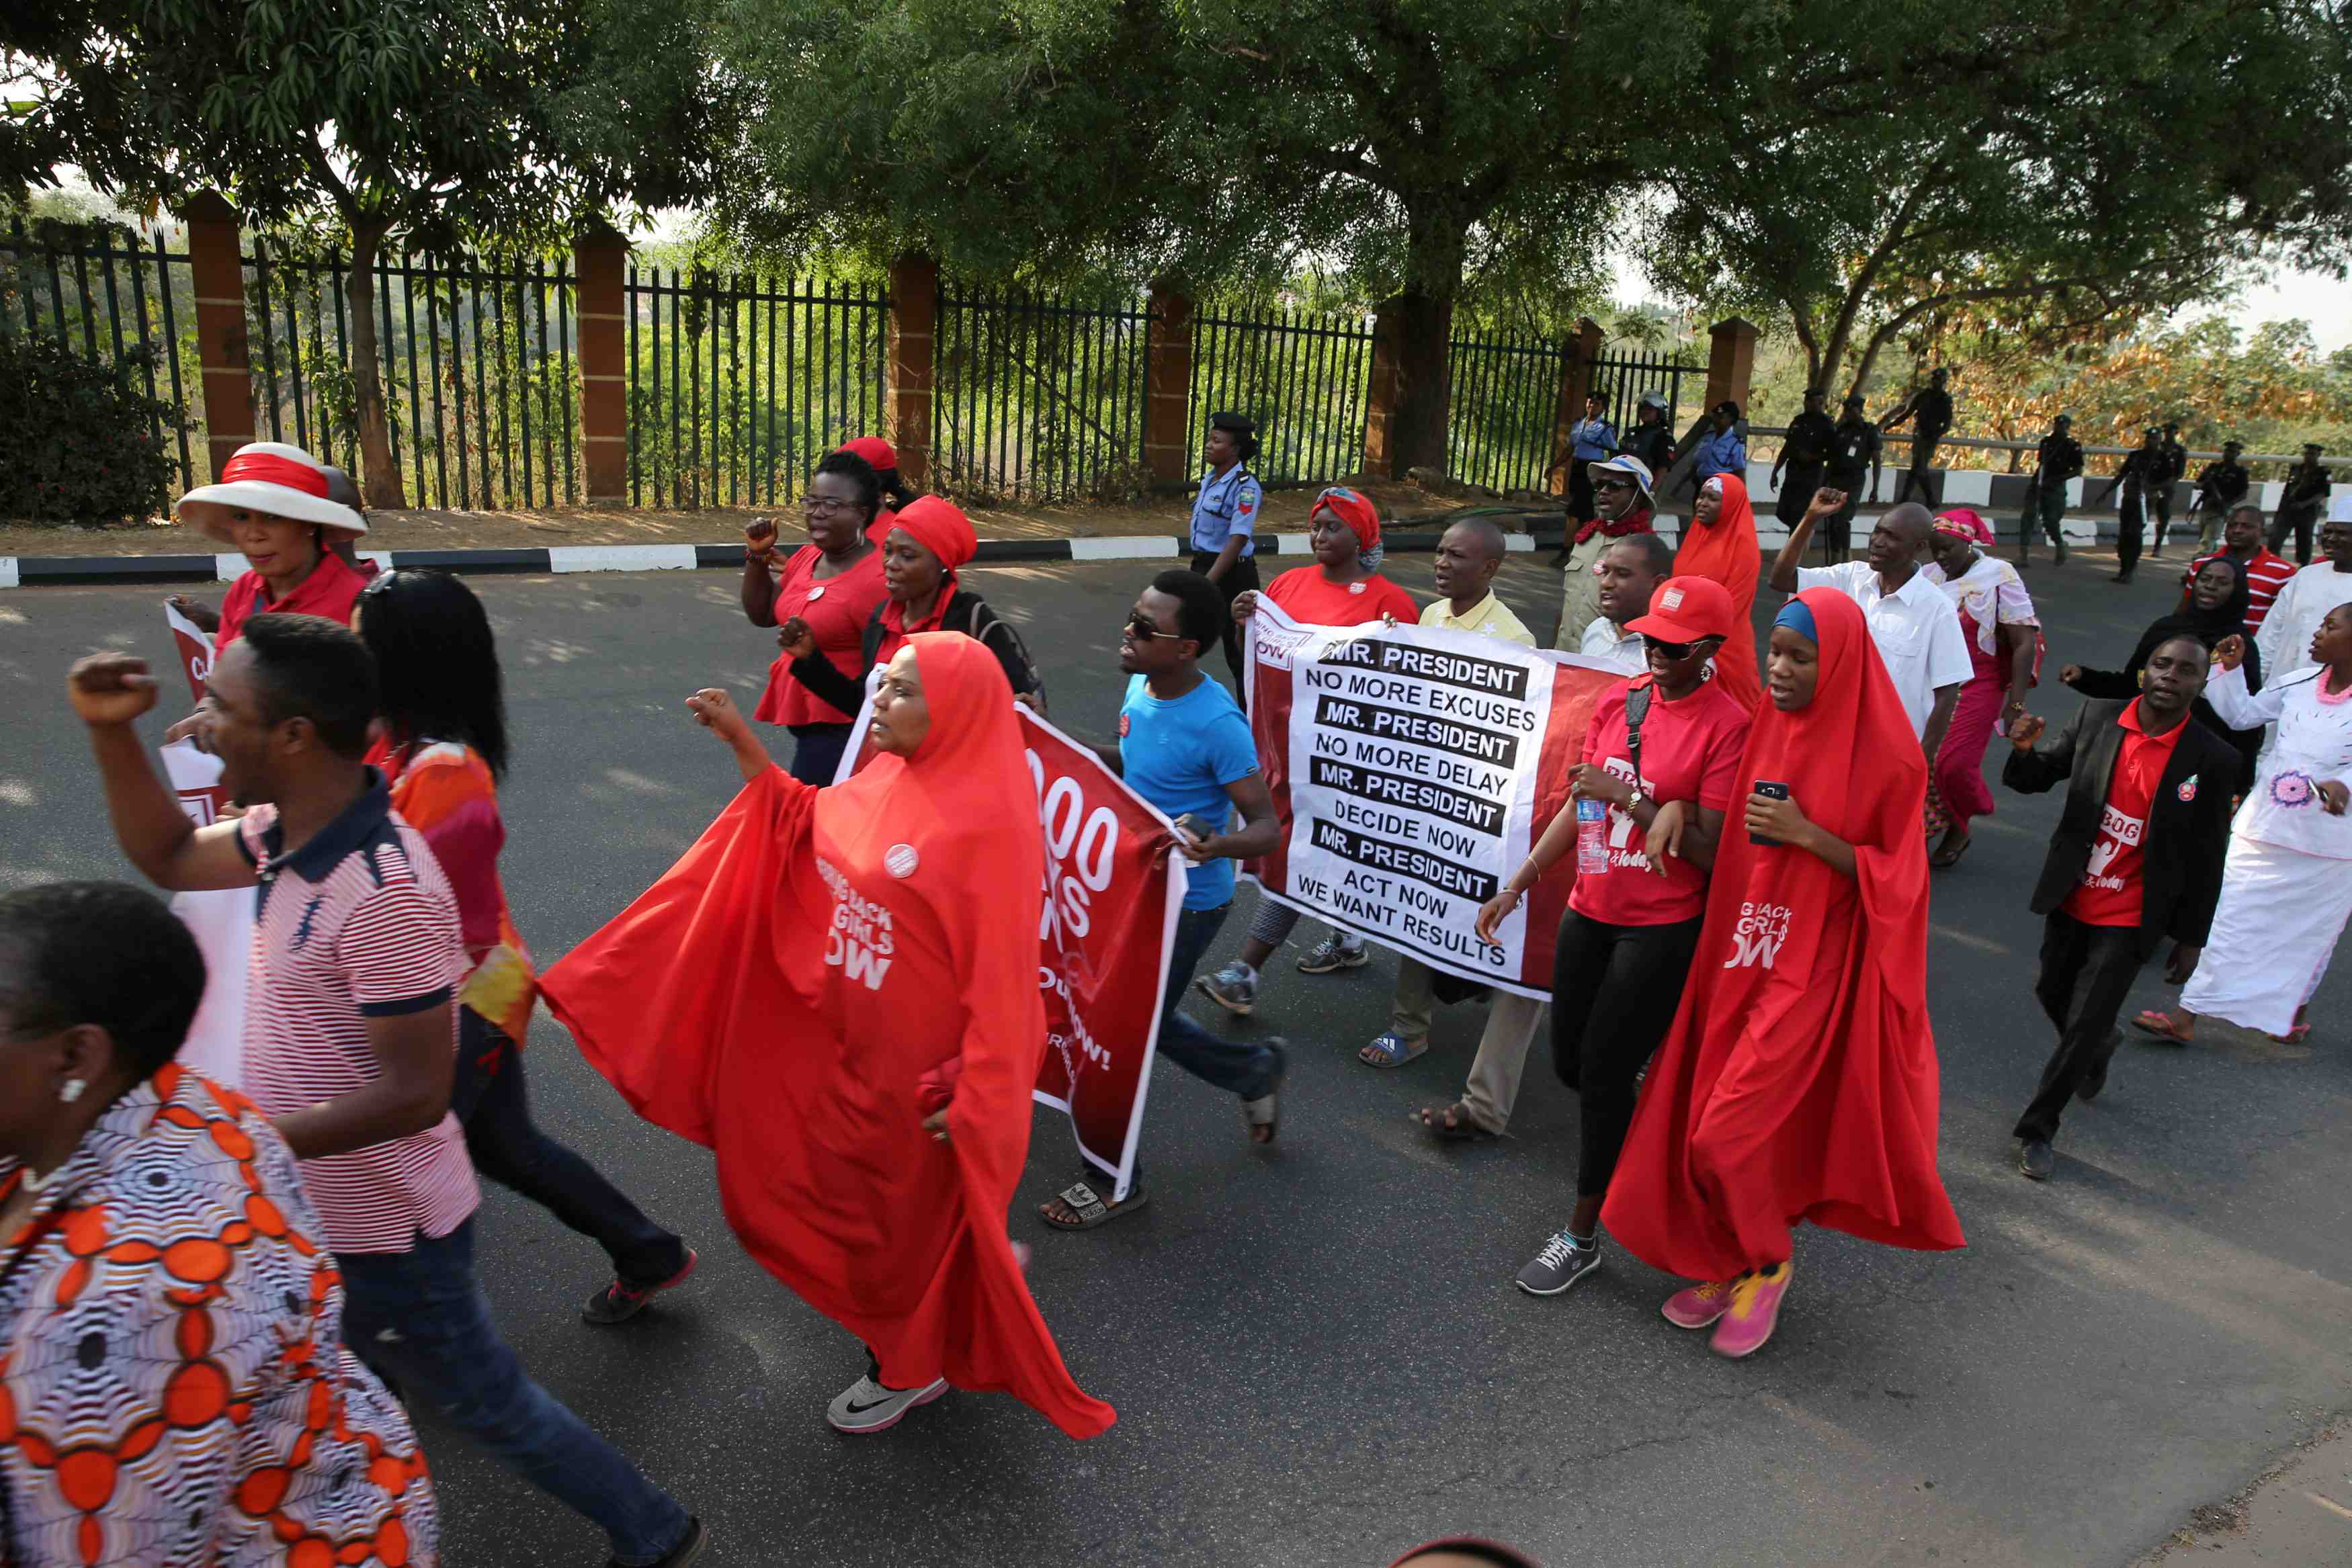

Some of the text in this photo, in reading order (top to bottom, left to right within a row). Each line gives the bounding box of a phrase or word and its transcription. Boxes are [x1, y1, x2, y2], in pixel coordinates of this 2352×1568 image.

[1329, 642, 1520, 692] MR. PRESIDENT
[1306, 668, 1536, 732] NO MORE EXCUSES
[1325, 702, 1511, 760] MR. PRESIDENT
[1316, 732, 1508, 796] NO MORE DELAY
[1320, 763, 1497, 828] MR. PRESIDENT
[2103, 810, 2139, 838] BOG
[1335, 799, 1476, 858] DECIDE NOW
[1319, 825, 1489, 898] MR. PRESIDENT
[1298, 874, 1506, 966] WE WANT RESULTS
[1343, 870, 1448, 918] ACT NOW
[1755, 903, 1793, 920] ACK
[824, 925, 893, 990] OW
[1723, 932, 1782, 969] OW
[1737, 916, 1788, 942] GRLS
